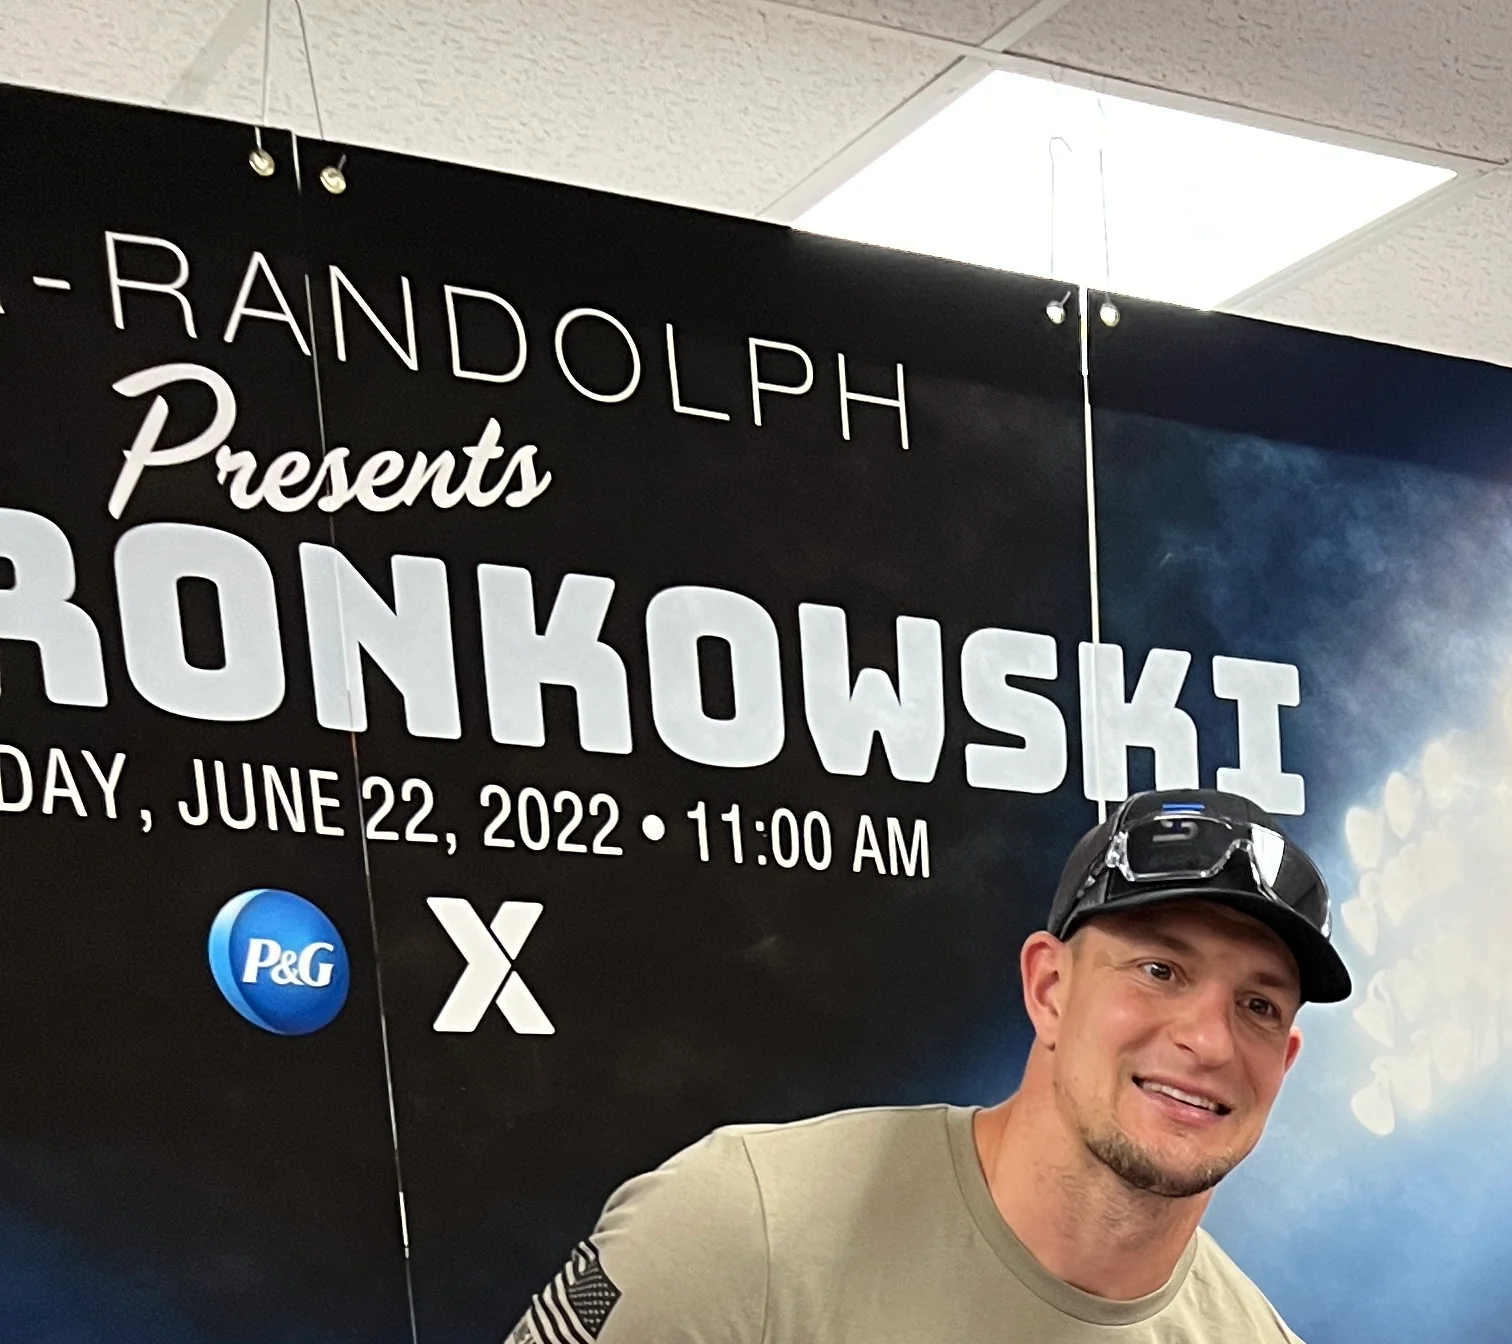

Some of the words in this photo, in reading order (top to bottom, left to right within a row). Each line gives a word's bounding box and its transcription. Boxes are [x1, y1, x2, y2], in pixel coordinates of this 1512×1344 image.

[0, 230, 910, 451] -RANDOLPH
[108, 363, 553, 519] Presents
[0, 744, 152, 833] DAY,
[177, 757, 345, 839] JUNE
[362, 775, 457, 856] 22,
[482, 783, 625, 856] 2022
[688, 801, 832, 872] 11:00
[852, 813, 931, 880] AM
[241, 937, 336, 991] P&G
